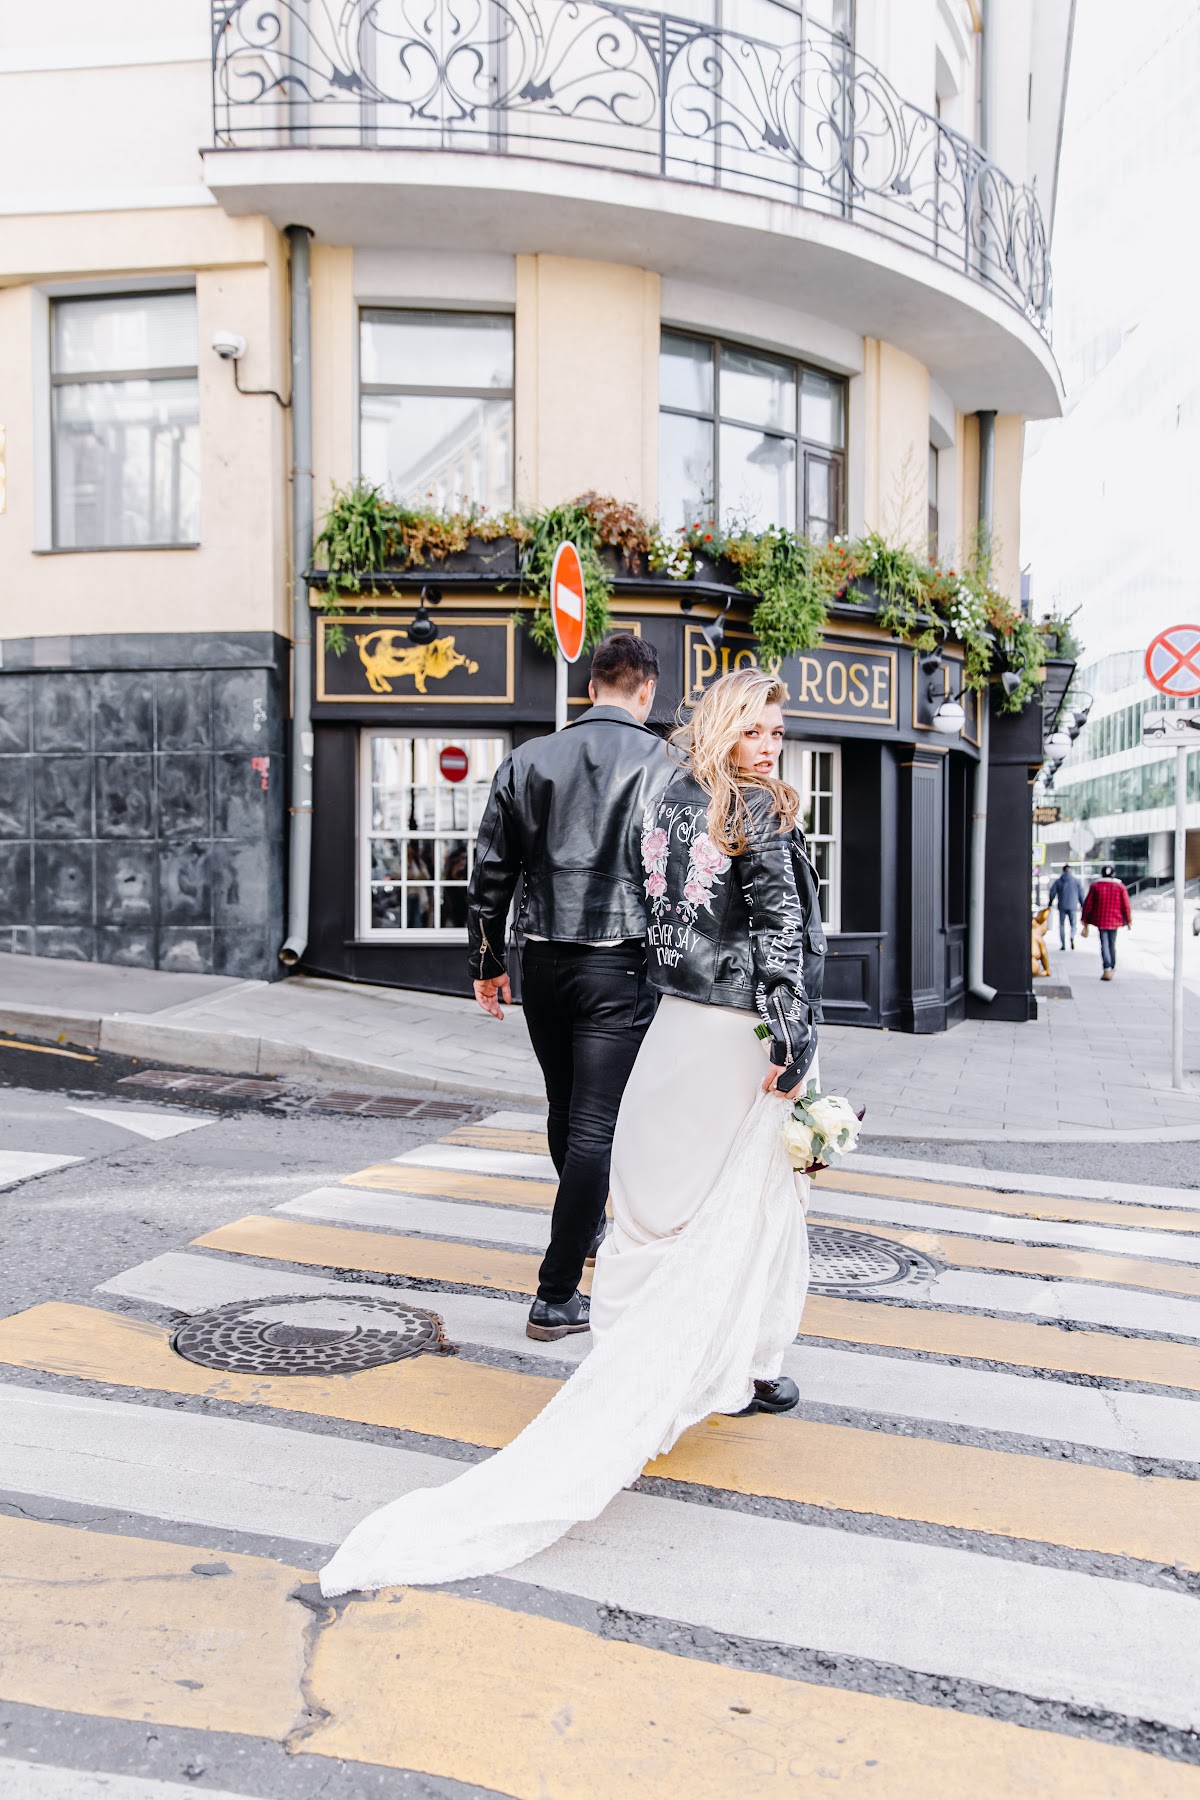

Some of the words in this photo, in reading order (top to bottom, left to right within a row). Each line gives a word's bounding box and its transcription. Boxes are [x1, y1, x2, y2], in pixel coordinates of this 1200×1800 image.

[799, 656, 889, 710] ROSE
[782, 892, 801, 910] IS
[647, 924, 674, 947] NEVER
[675, 926, 701, 953] SAY
[765, 911, 801, 971] YESTERDAY
[656, 946, 684, 969] never
[783, 997, 803, 1024] Never
